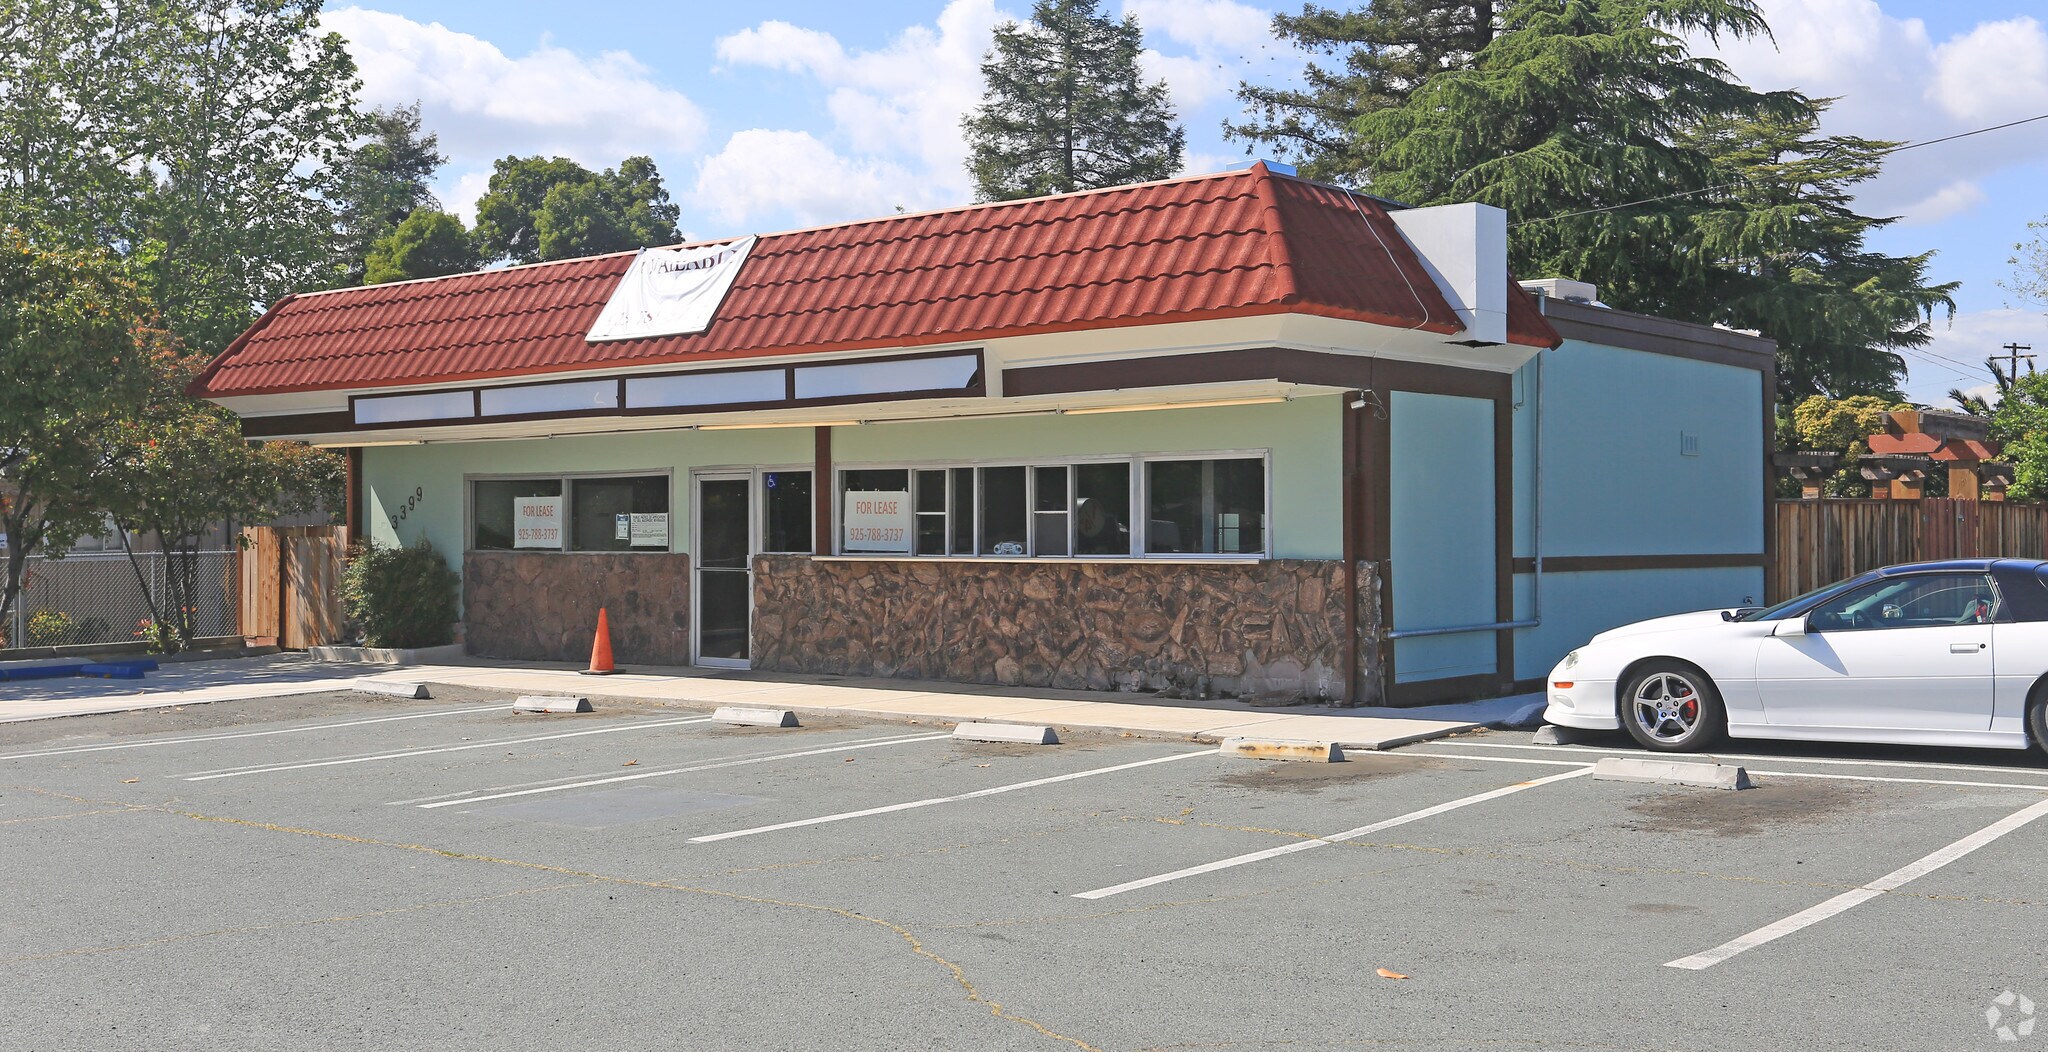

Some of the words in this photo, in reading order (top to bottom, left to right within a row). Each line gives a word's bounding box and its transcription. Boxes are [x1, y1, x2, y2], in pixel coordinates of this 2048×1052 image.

[391, 486, 423, 530] 3399
[522, 505, 535, 517] FOR
[536, 505, 554, 517] LEASE
[856, 501, 872, 515] FOR
[874, 501, 898, 515] LEASE
[518, 528, 558, 540] 925-788-3737
[850, 527, 904, 541] 925-788-3737
